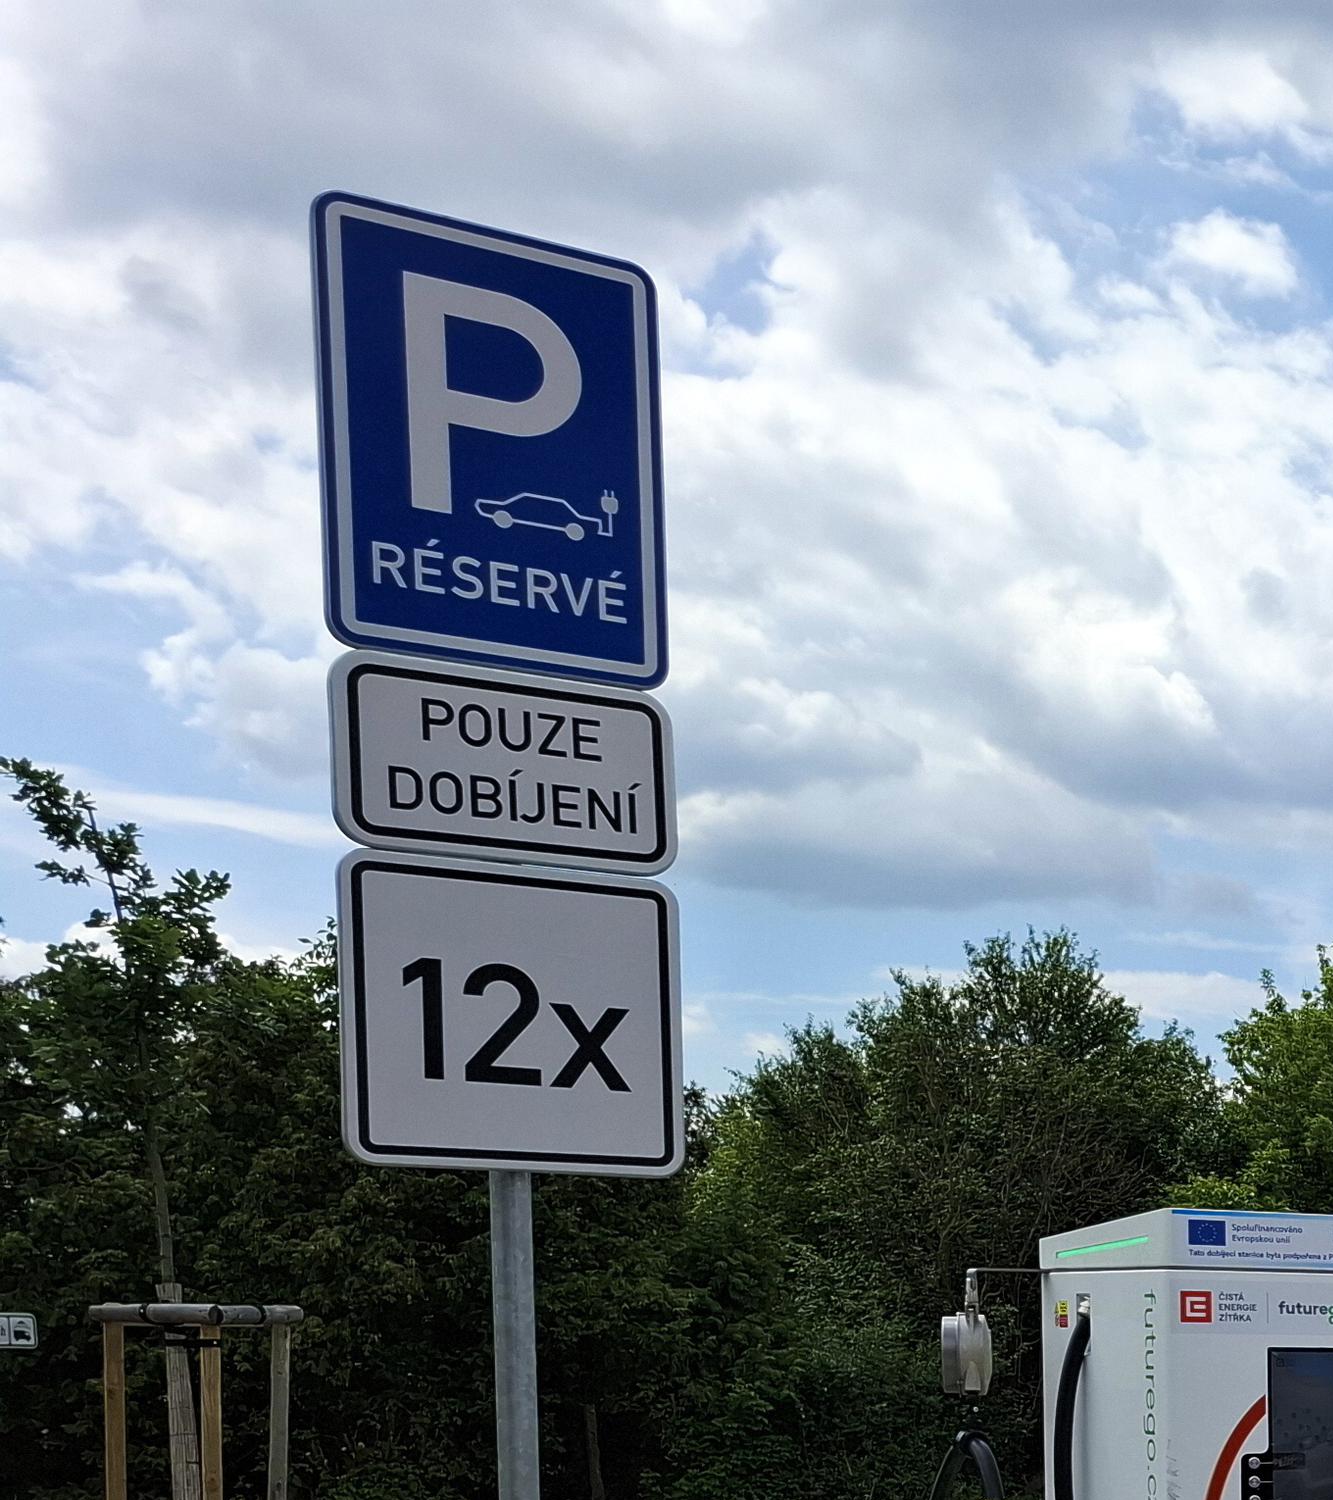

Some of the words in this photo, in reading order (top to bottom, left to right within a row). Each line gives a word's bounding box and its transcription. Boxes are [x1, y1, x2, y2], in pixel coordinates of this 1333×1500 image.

[402, 271, 583, 514] P
[370, 538, 628, 625] RÉSERVÉ
[420, 696, 603, 764] POUZE
[386, 763, 643, 836] DOBÍJENÍ
[401, 957, 632, 1093] 12x
[1231, 1234, 1273, 1244] Evropskou
[1218, 1291, 1244, 1301] ČISTÁ
[1218, 1303, 1257, 1312] ENERGIE
